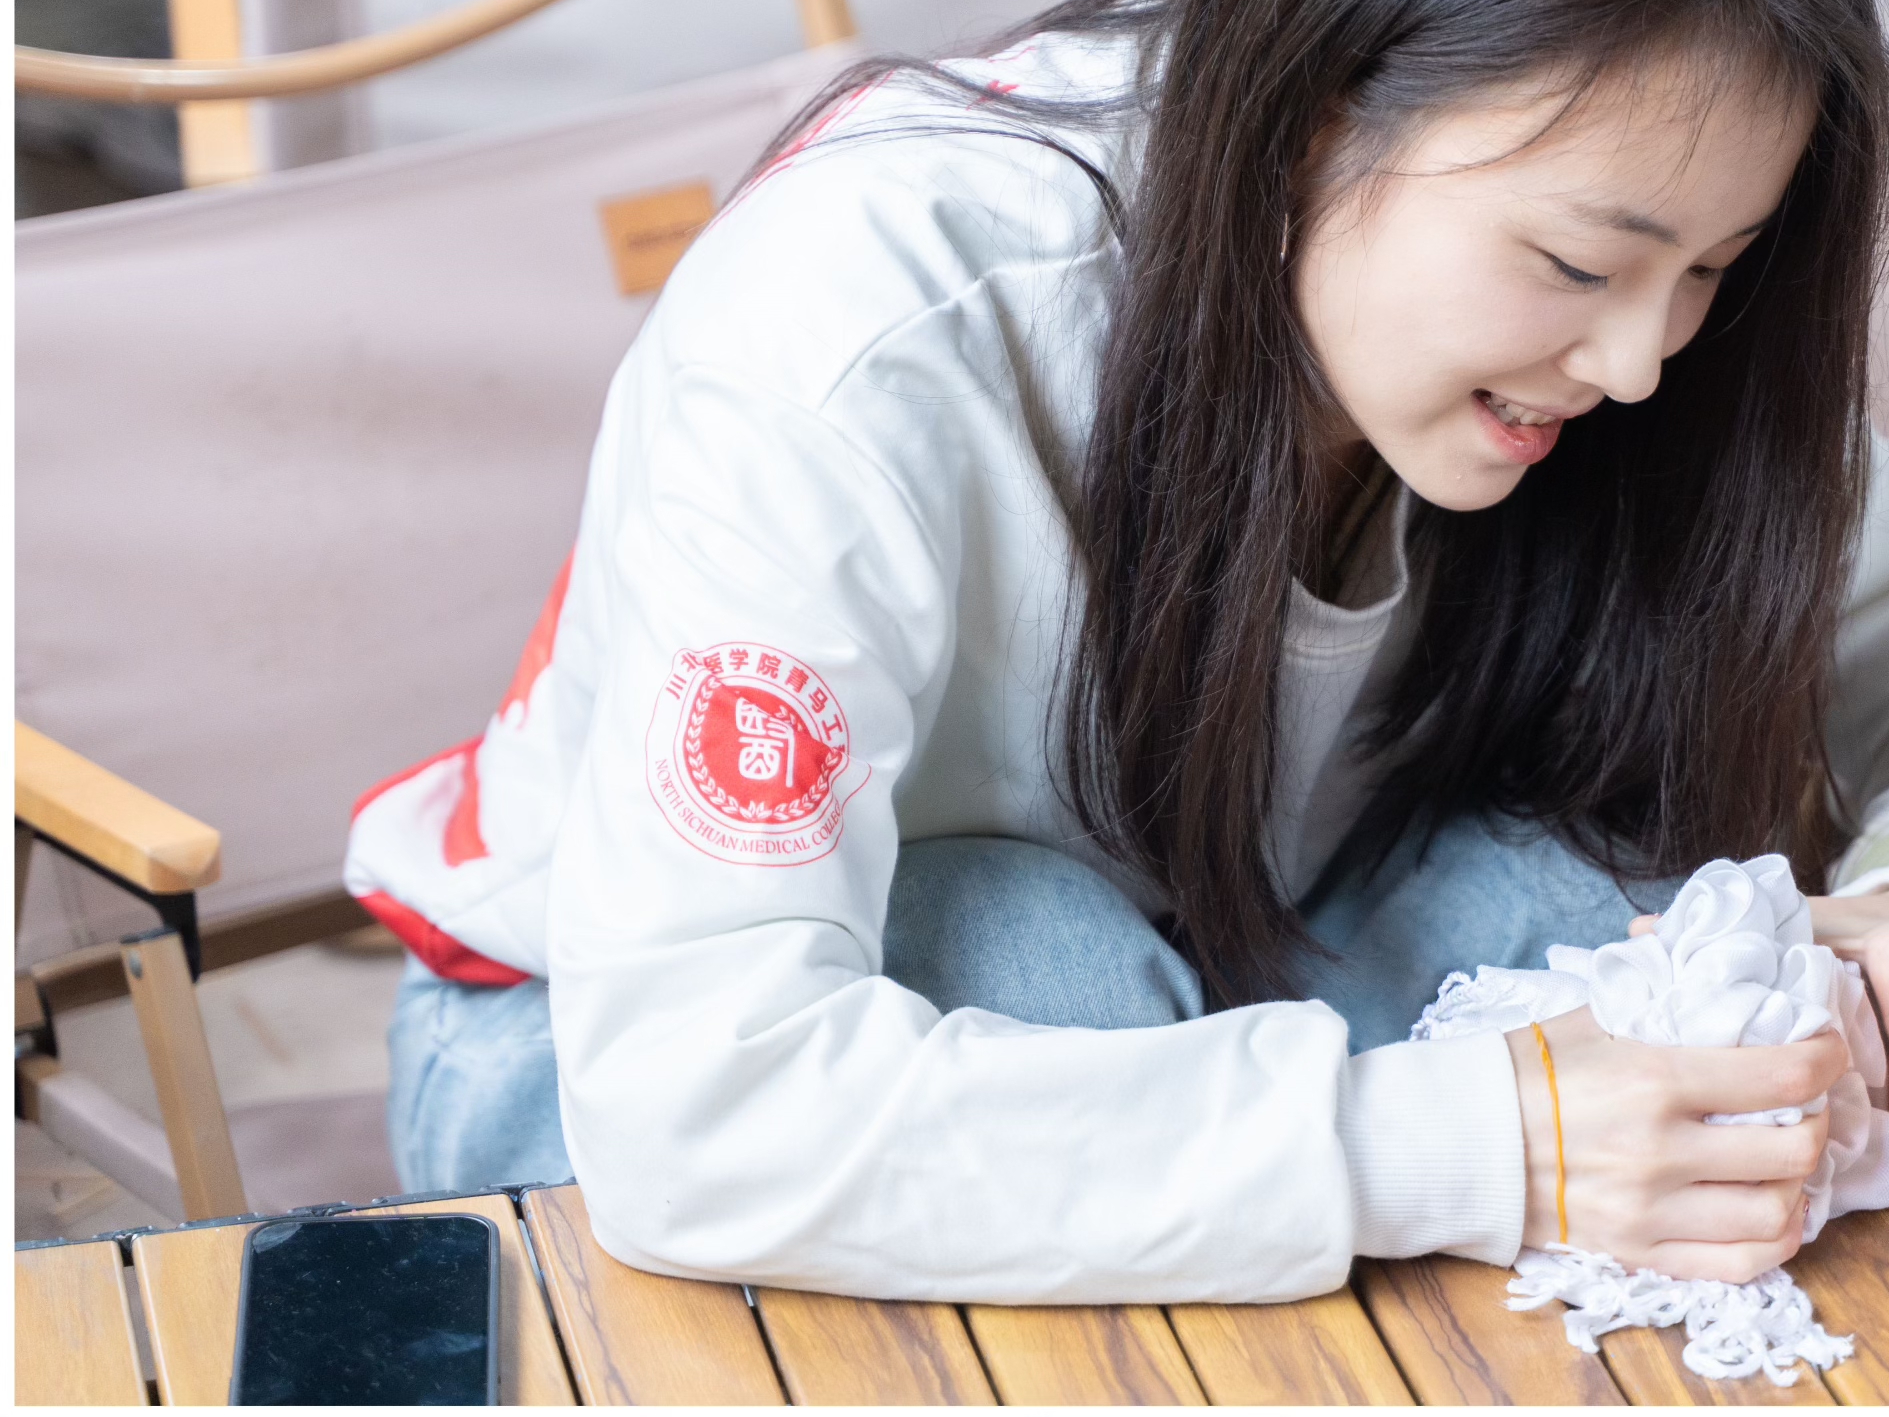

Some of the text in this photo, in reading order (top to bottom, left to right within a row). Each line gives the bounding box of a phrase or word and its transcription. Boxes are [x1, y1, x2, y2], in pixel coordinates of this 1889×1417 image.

[654, 758, 683, 809] NORTH
[678, 805, 740, 851] SICHUAN
[740, 835, 811, 855] MEDICAL
